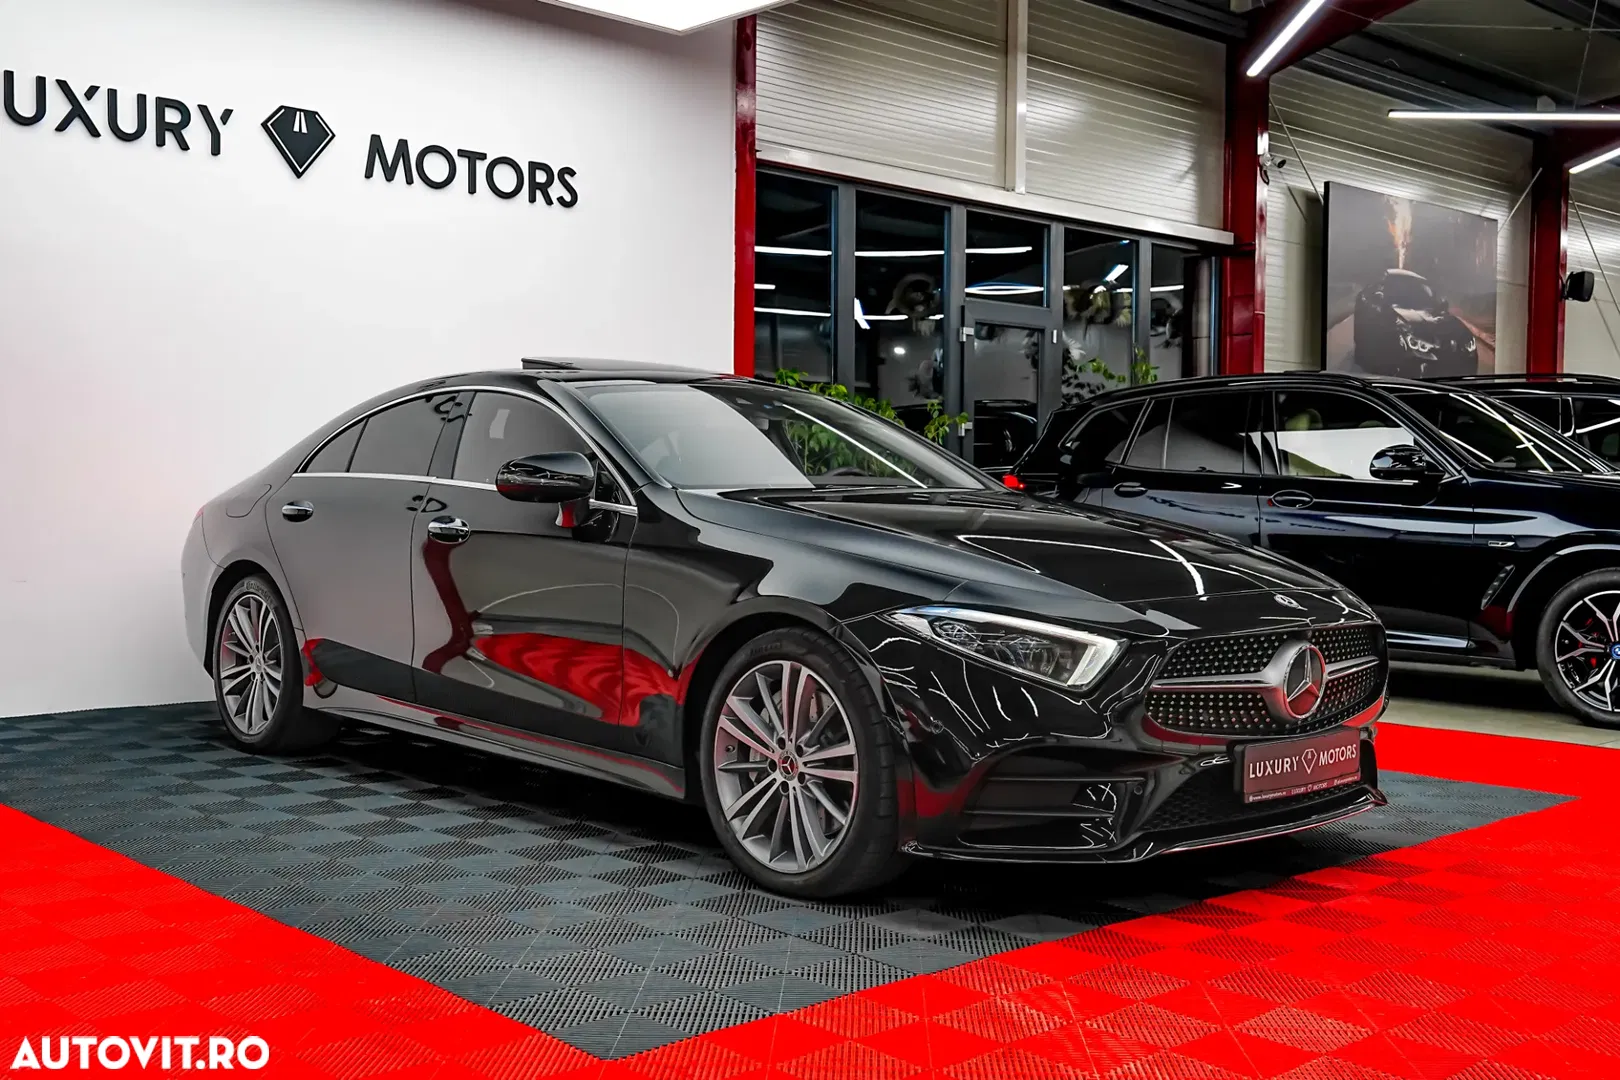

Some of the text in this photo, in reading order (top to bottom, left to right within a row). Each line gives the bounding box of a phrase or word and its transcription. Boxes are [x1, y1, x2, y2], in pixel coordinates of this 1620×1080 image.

[365, 134, 578, 208] MOTORS
[1249, 743, 1357, 779] LUXURY MOTORS
